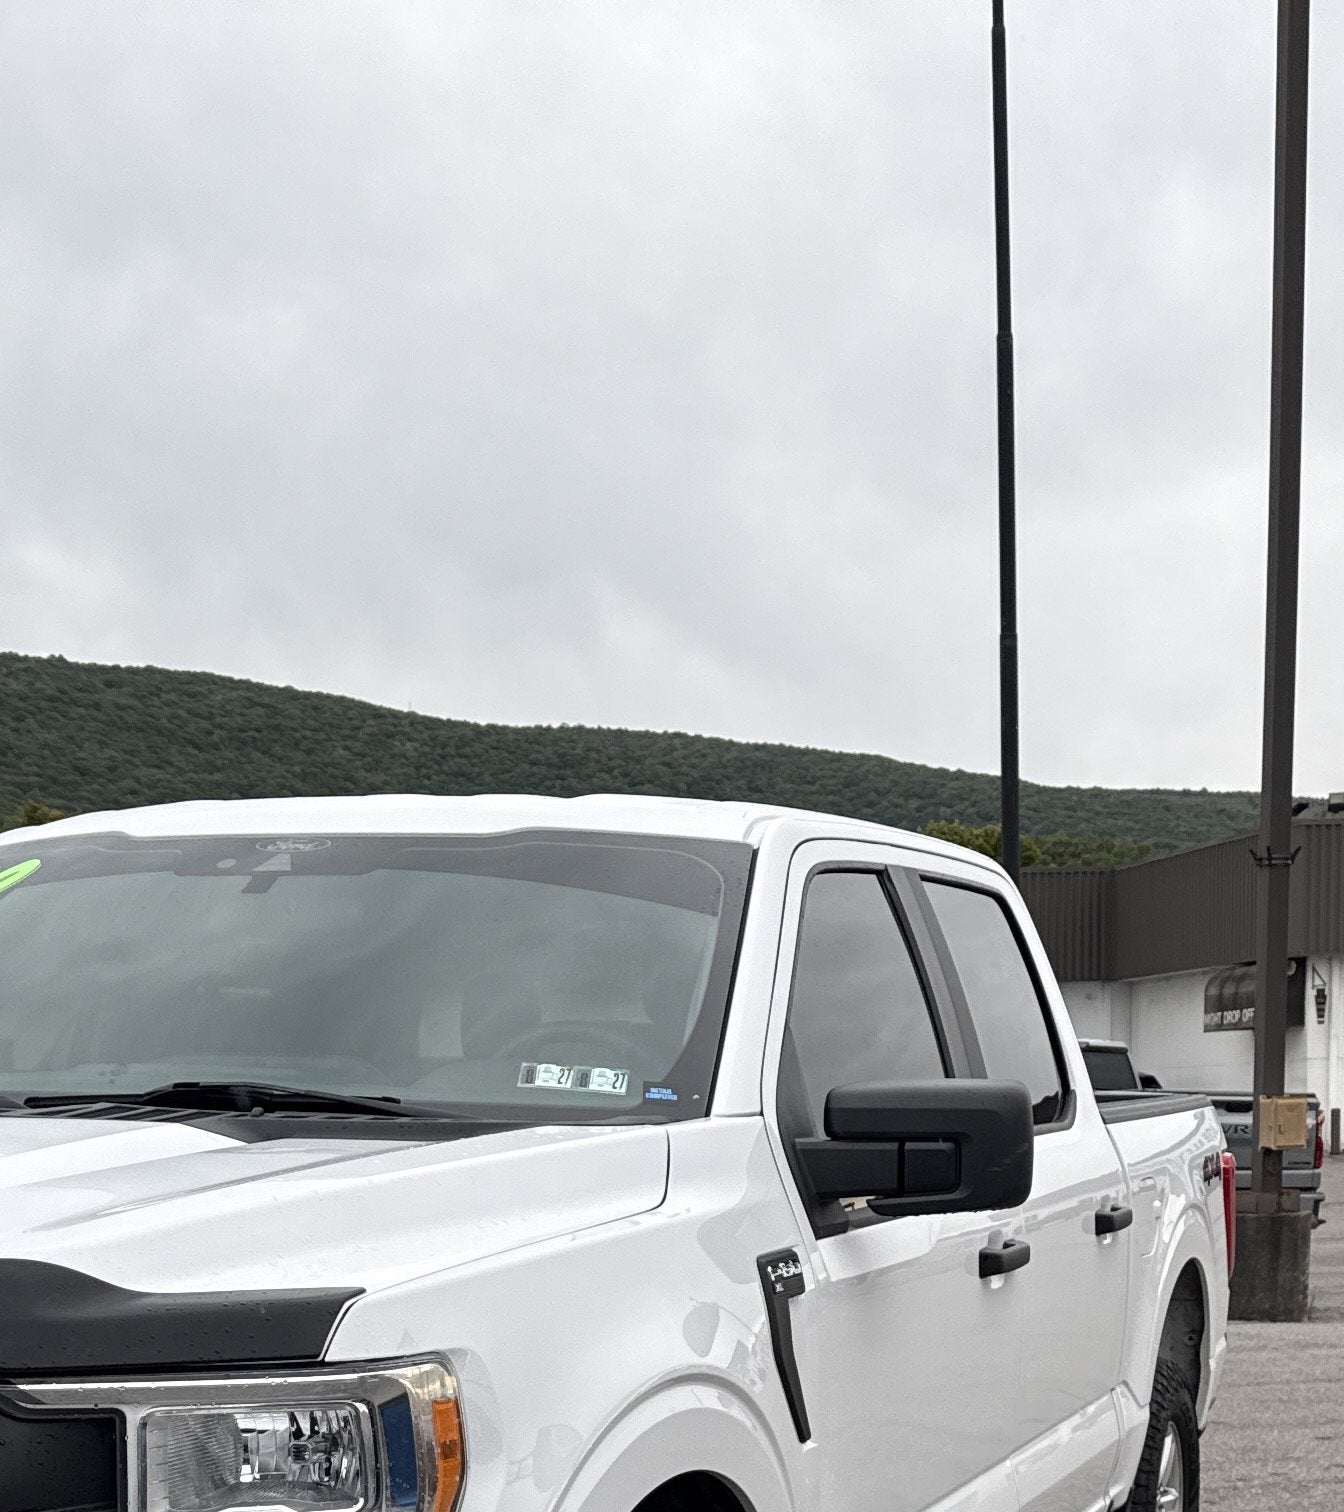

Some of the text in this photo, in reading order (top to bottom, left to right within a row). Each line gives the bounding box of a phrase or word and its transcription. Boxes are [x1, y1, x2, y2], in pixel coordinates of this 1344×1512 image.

[1223, 1009, 1241, 1025] DROP
[1242, 1007, 1256, 1024] OFF
[557, 1067, 573, 1085] 27
[612, 1072, 626, 1090] 27
